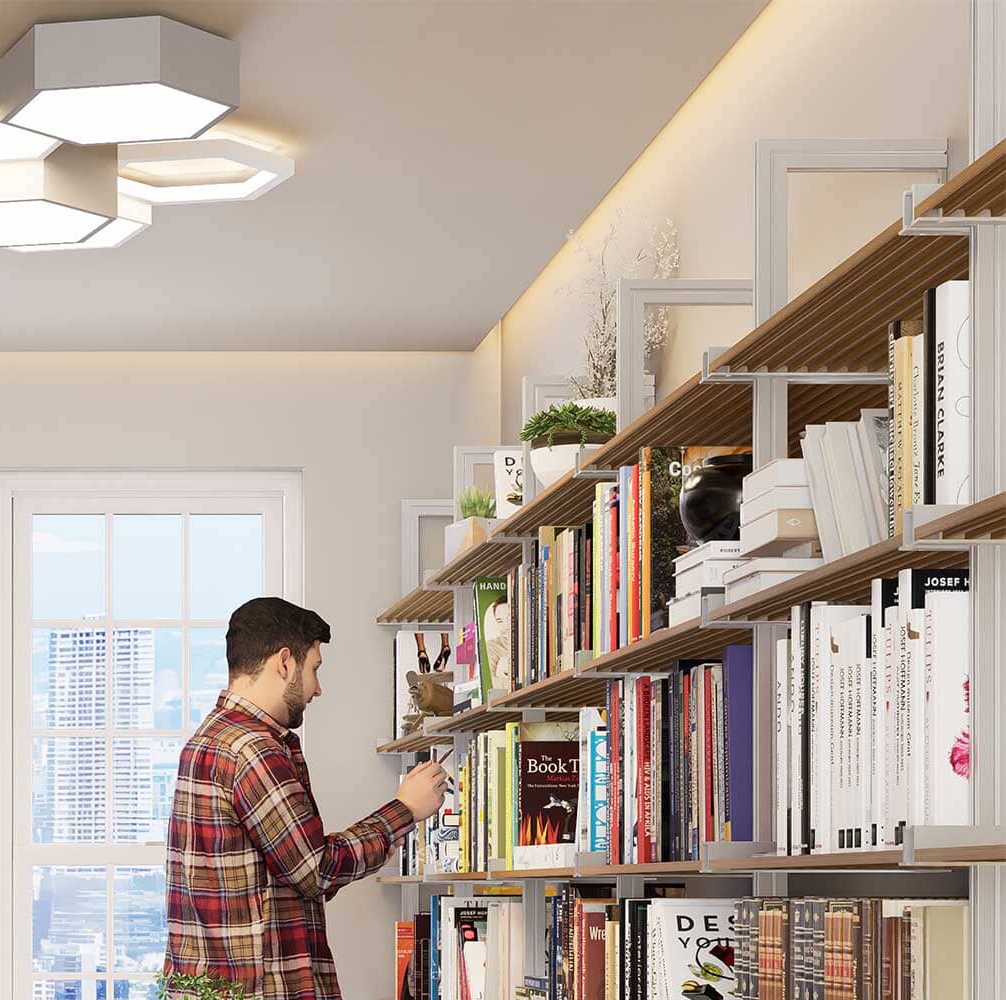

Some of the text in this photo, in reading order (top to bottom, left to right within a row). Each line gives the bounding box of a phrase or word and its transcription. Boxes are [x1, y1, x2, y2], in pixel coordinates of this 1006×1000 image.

[937, 341, 945, 479] BRIAN CLARKE
[913, 461, 921, 487] Jane
[479, 582, 507, 591] HAND
[924, 576, 961, 587] JOSEF
[643, 690, 651, 719] BROKEN
[643, 720, 651, 762] LANDSCAPE
[527, 758, 567, 774] Book
[643, 761, 651, 775] HIV
[546, 774, 569, 782] Markus
[643, 783, 651, 801] AIDS
[643, 801, 651, 810] IN
[643, 811, 651, 837] AFRICA
[589, 925, 606, 940] Wre
